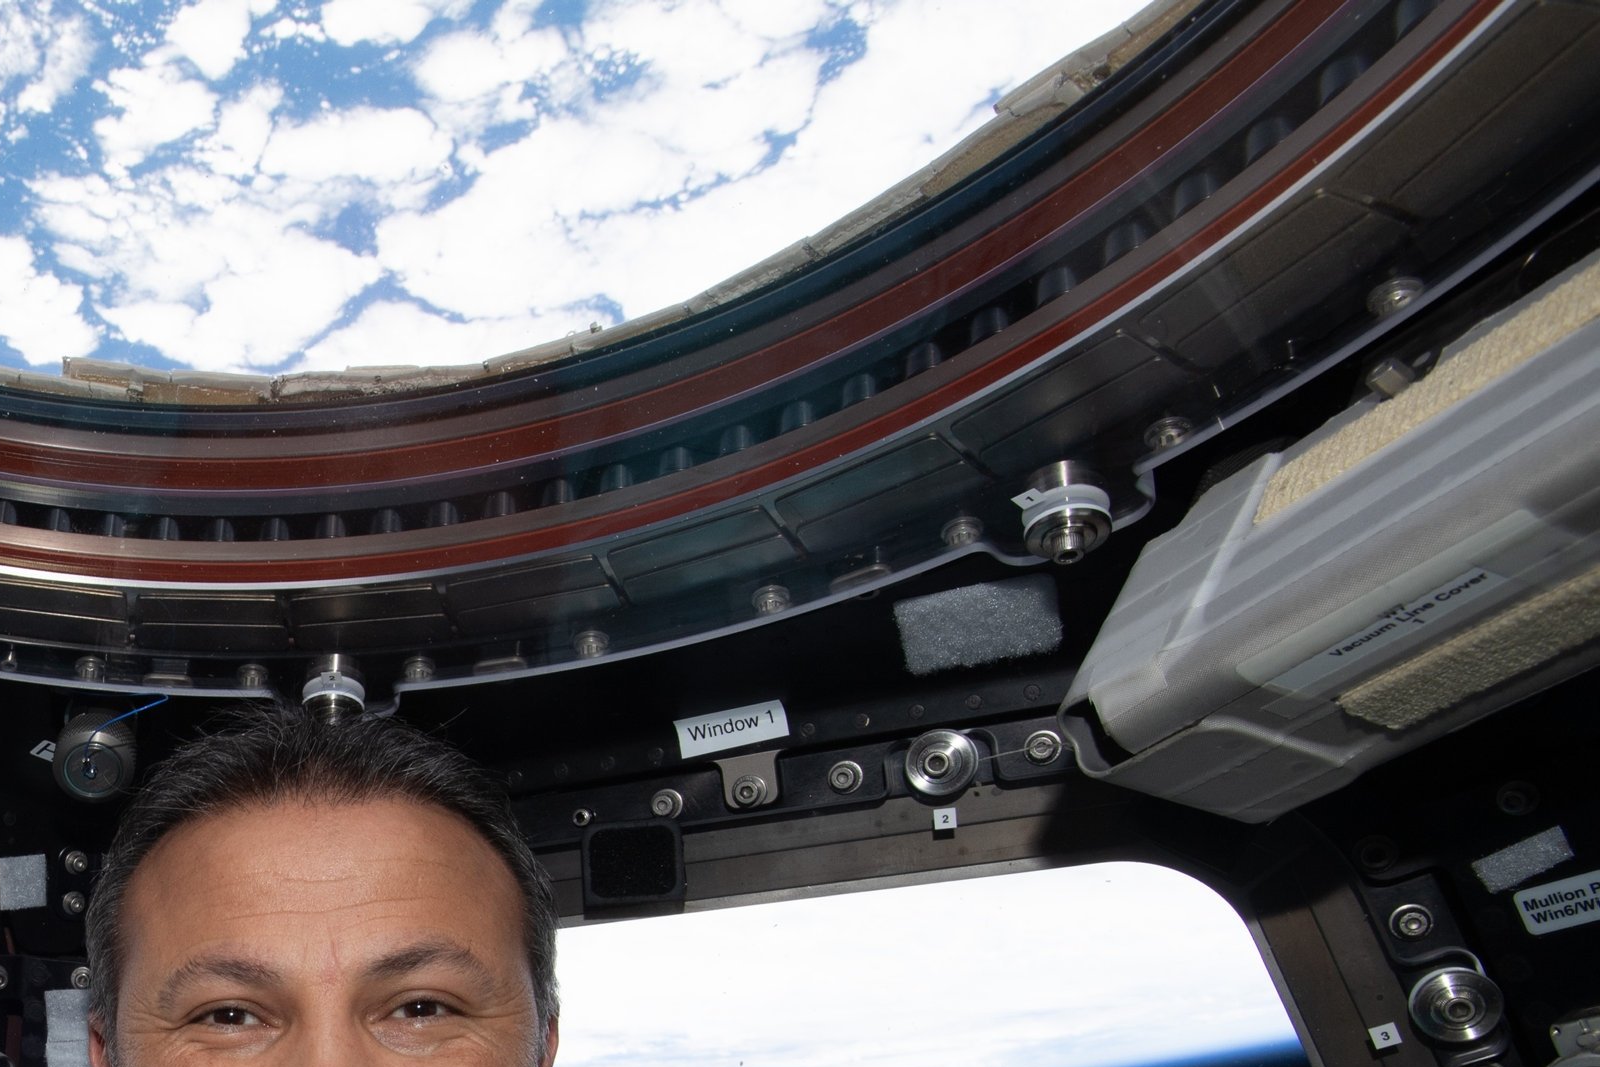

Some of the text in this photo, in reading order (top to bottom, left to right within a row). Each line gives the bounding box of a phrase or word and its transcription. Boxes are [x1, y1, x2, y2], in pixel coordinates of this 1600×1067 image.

[1329, 573, 1488, 657] Vacuum Line Cover
[687, 709, 775, 742] Window 1
[942, 814, 949, 823] 2
[1523, 889, 1586, 911] Mullion
[1380, 1031, 1390, 1041] 3
